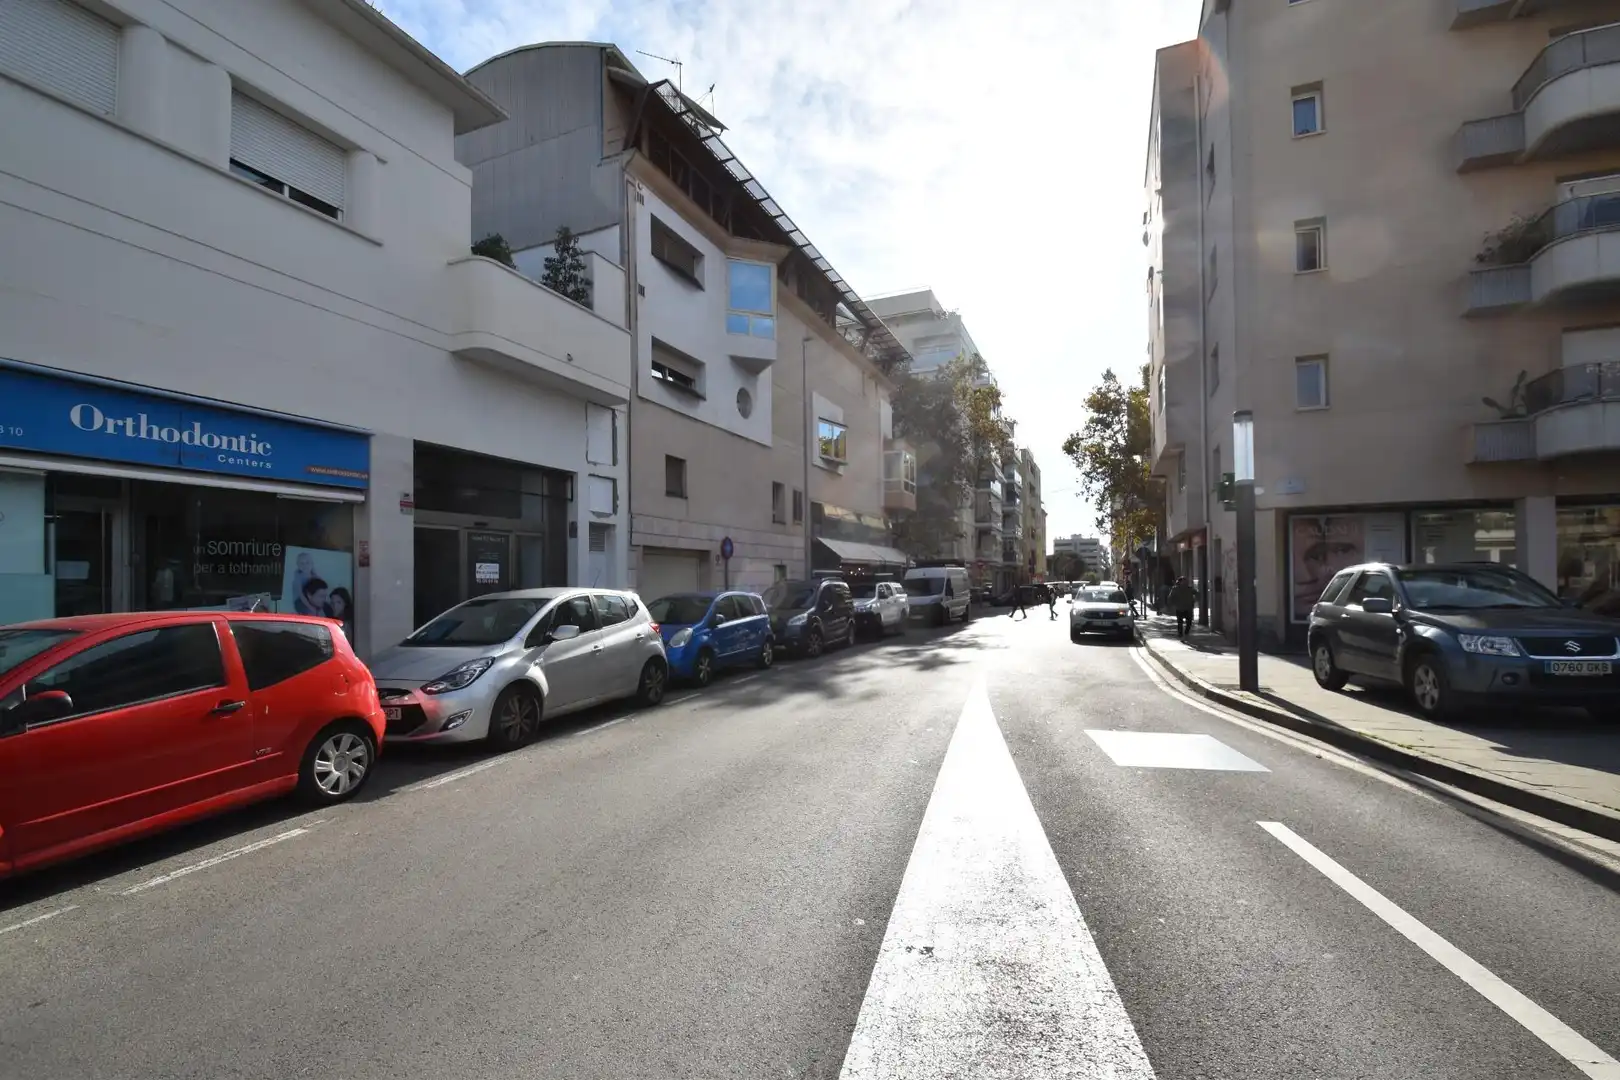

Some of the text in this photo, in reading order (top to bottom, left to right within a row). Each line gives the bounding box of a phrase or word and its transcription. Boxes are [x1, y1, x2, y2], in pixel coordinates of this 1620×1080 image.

[8, 426, 24, 437] 10
[69, 403, 273, 457] Orthodontic
[217, 454, 272, 469] Centers
[207, 537, 282, 557] somriure
[193, 562, 215, 578] per
[217, 563, 226, 574] a
